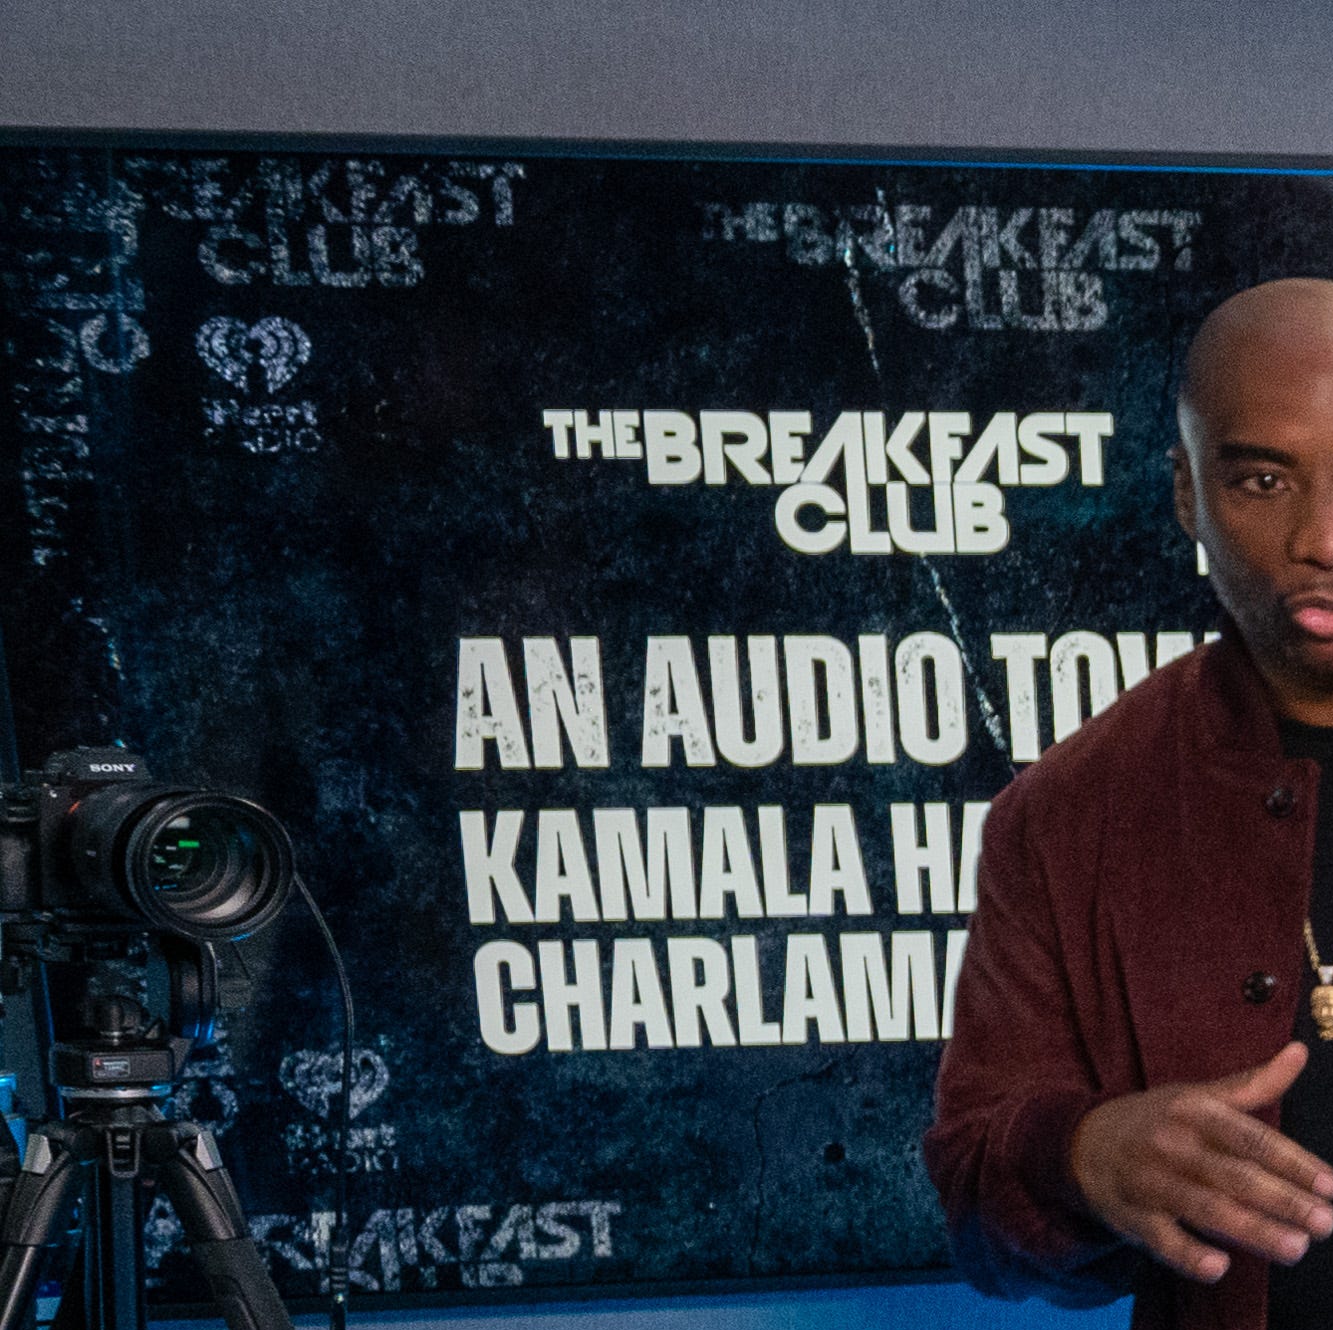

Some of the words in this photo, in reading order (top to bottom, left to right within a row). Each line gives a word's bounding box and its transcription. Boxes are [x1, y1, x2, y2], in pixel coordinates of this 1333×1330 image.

[899, 268, 1108, 332] CLUB
[543, 409, 643, 460] THE
[643, 410, 1114, 486] BREAKFAST
[774, 481, 1012, 555] CLUB
[454, 636, 610, 770] AN
[641, 631, 968, 768] AUDIO
[90, 763, 137, 773] SONY
[459, 804, 873, 924] KAMALA
